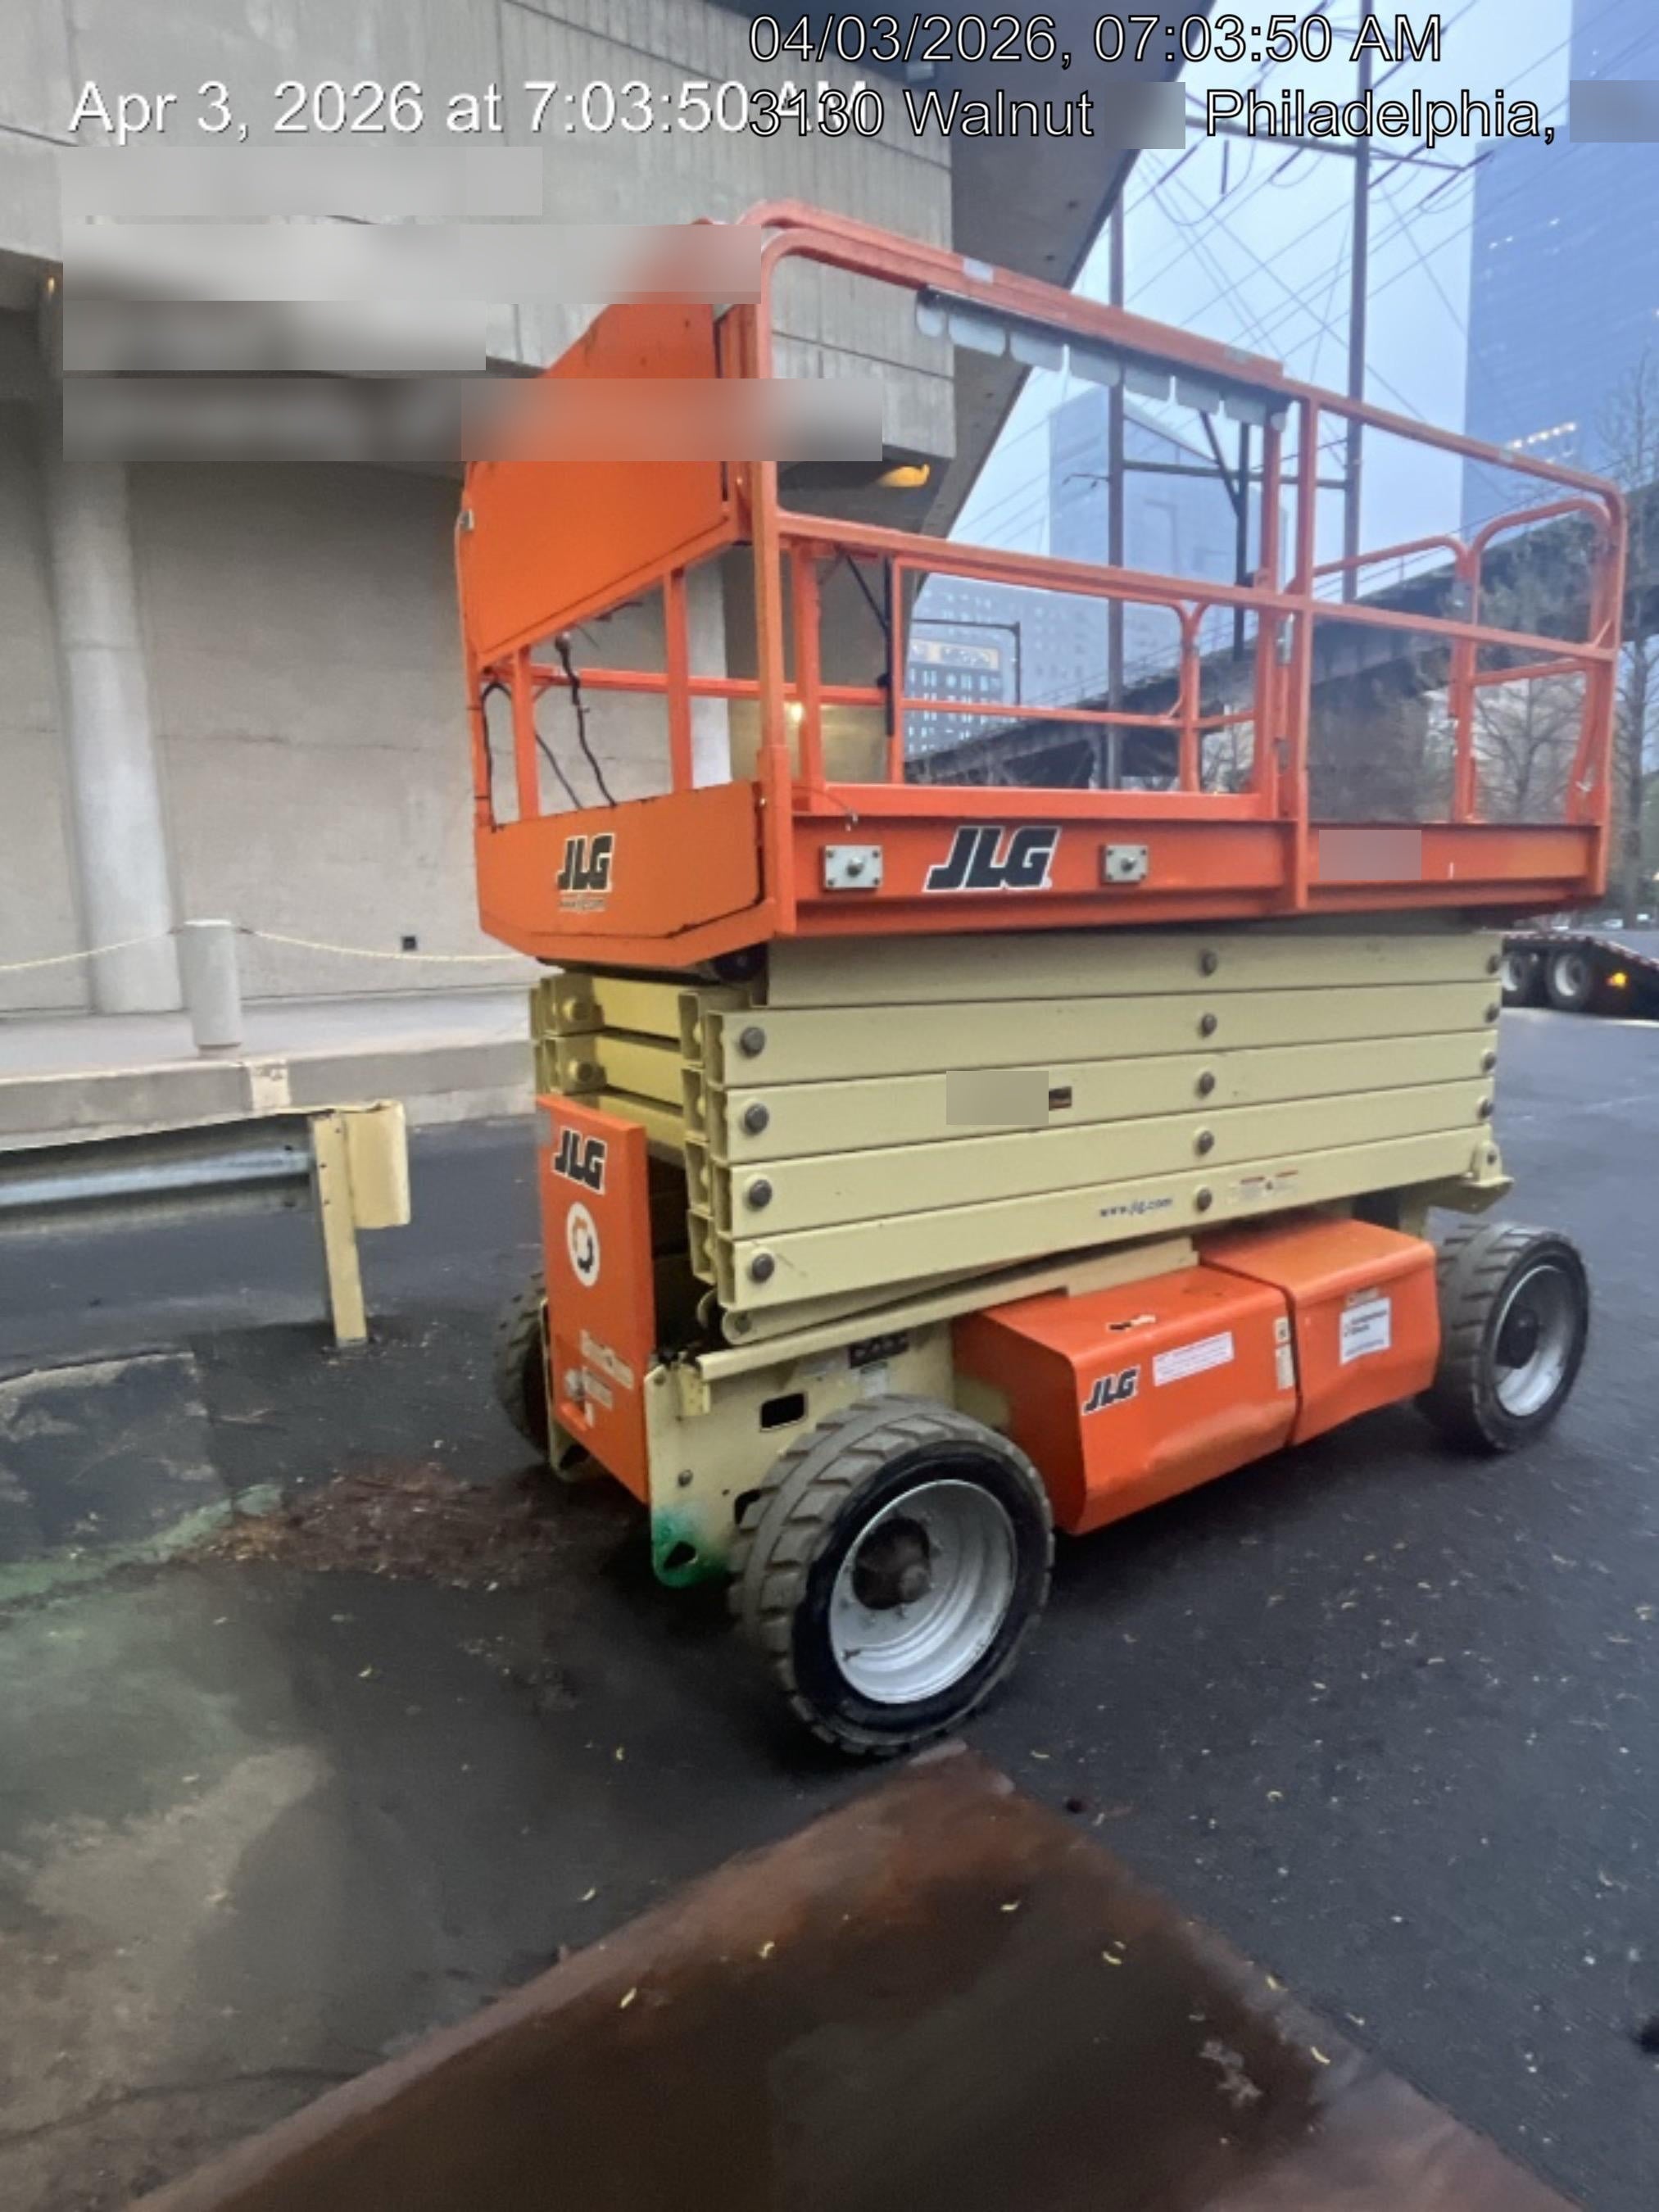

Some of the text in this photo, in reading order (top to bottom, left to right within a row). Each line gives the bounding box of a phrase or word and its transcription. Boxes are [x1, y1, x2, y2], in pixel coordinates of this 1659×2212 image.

[555, 833, 616, 893] JLG
[922, 825, 1063, 893] JLG
[552, 1126, 608, 1195] JLG
[1081, 1364, 1141, 1416] JLG
